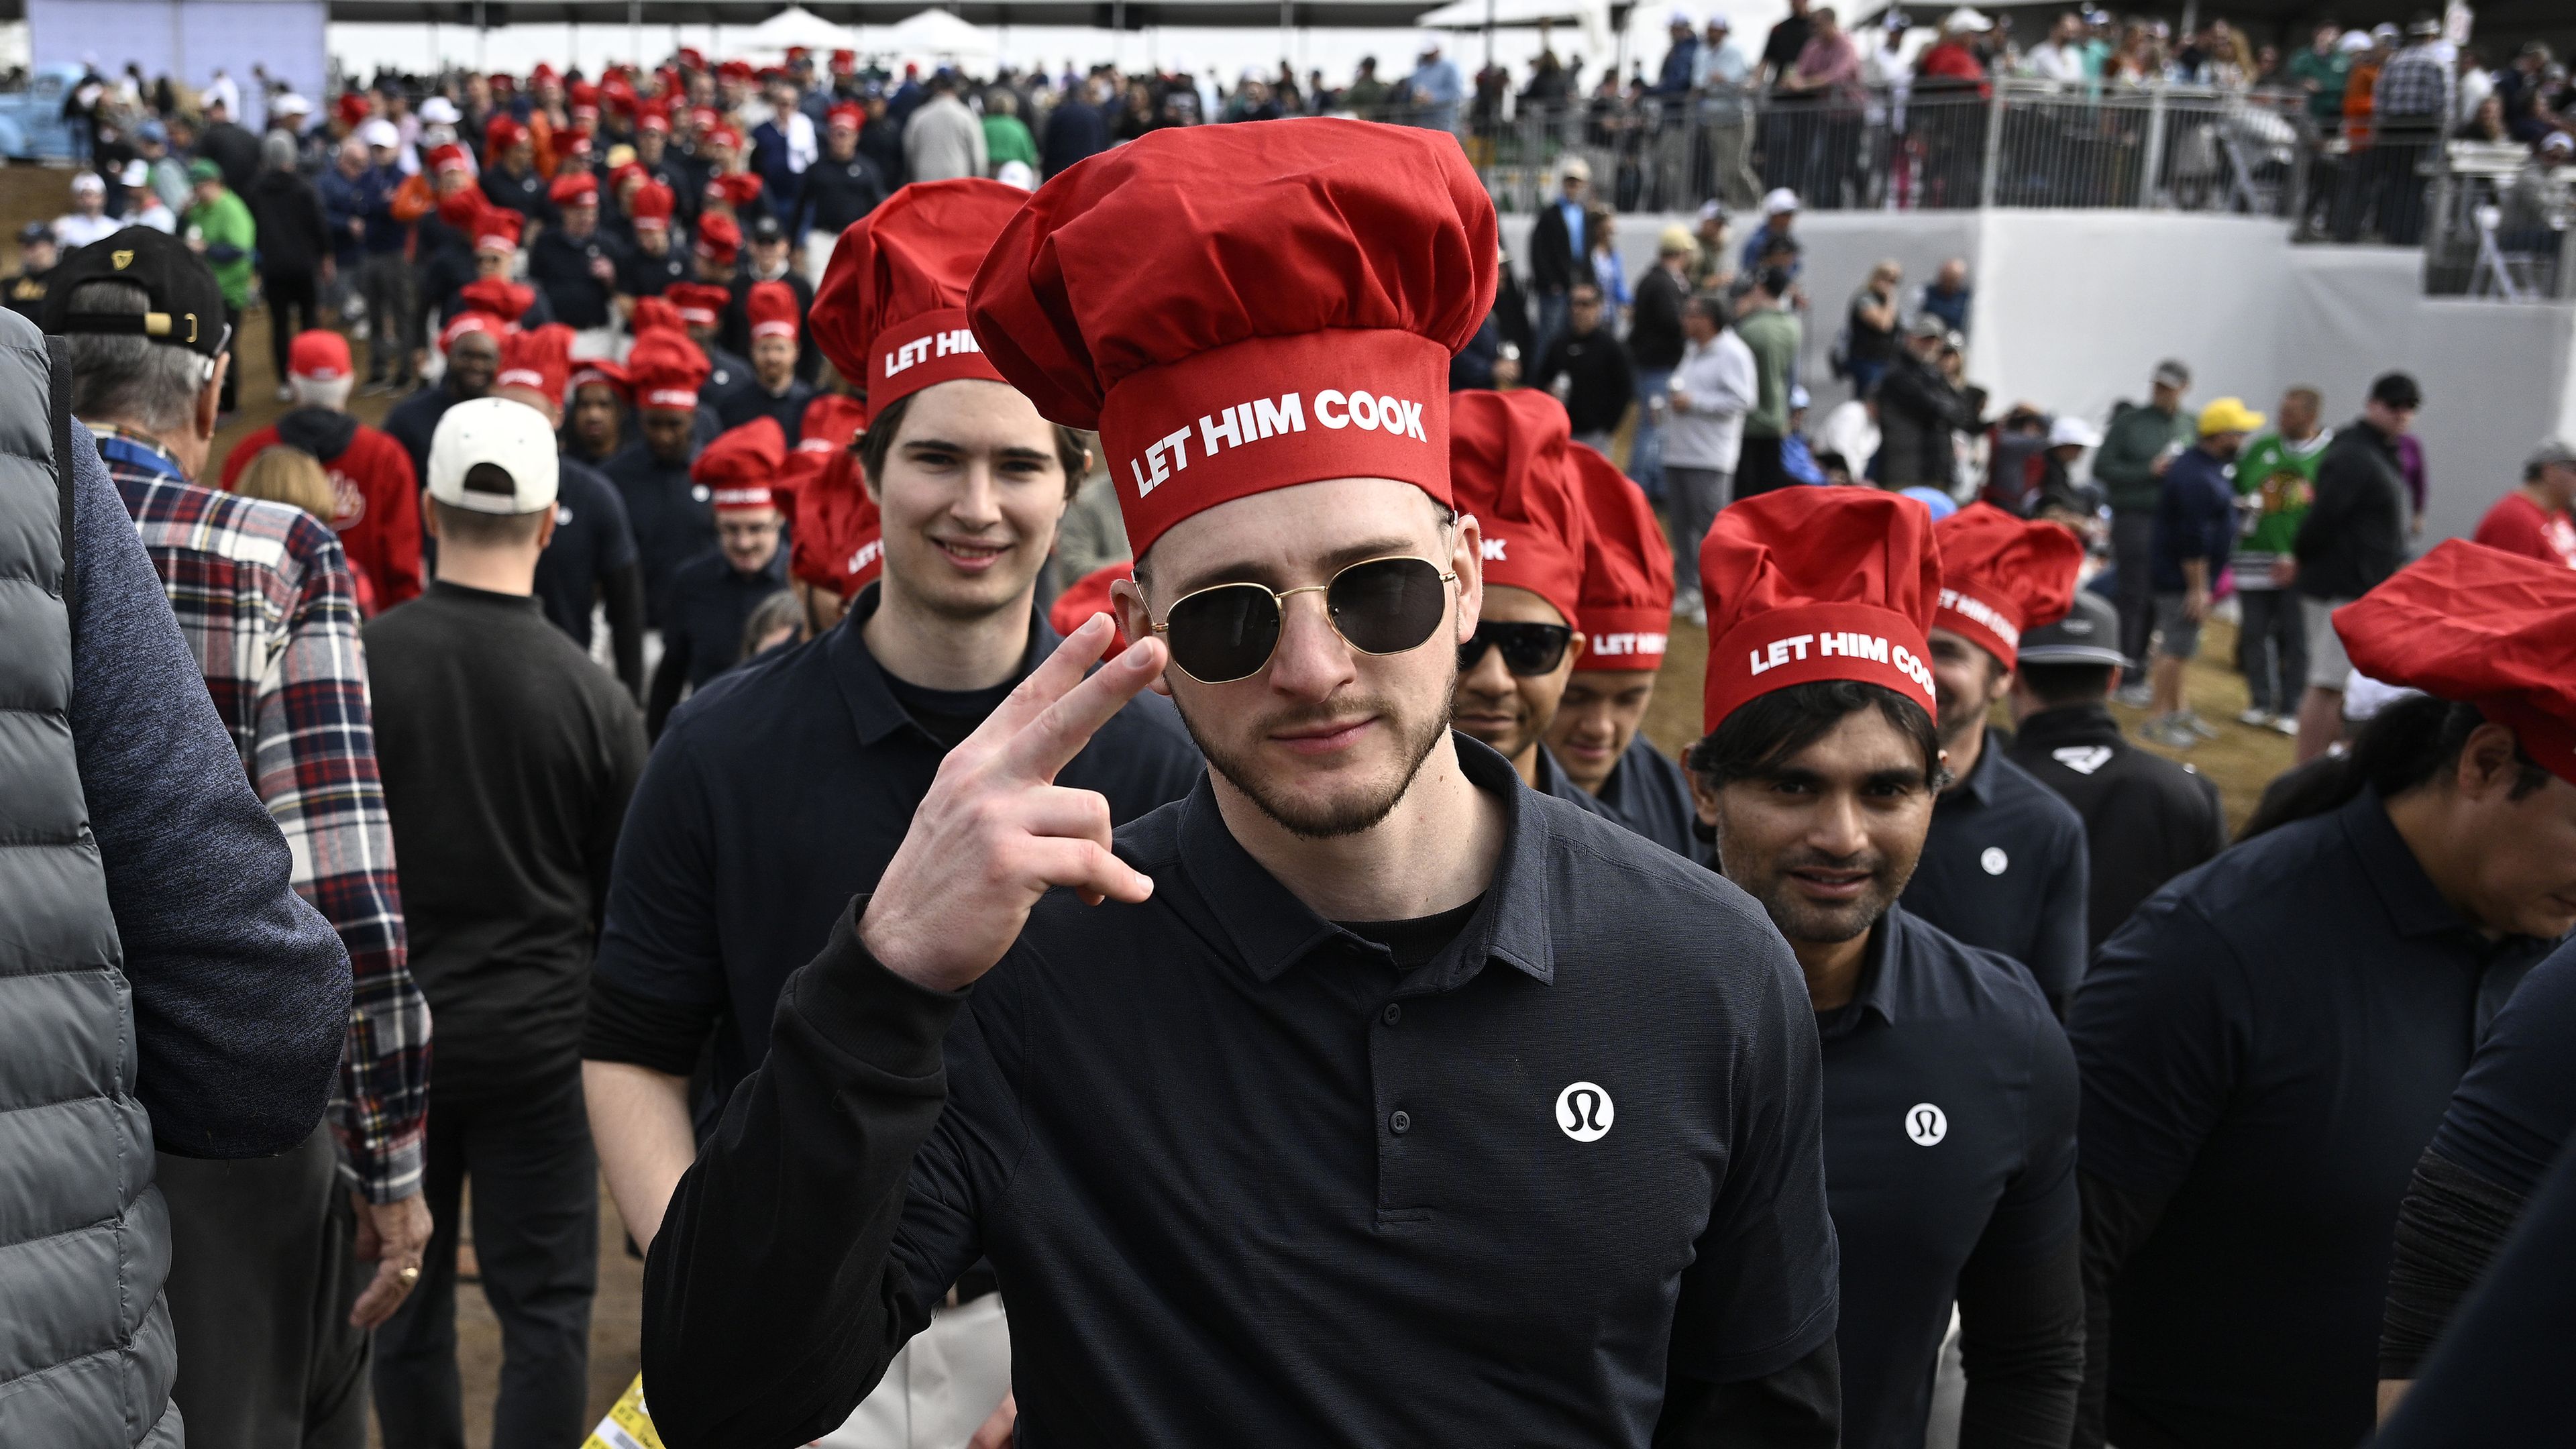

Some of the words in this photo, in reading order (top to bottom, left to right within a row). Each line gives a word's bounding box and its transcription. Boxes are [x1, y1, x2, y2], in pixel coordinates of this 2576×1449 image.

[885, 335, 933, 379] LET
[1130, 425, 1192, 499] LET
[1198, 392, 1307, 458] HIM
[1313, 389, 1428, 443] COOK
[1593, 633, 1636, 655] LET
[1750, 633, 1814, 676] LET
[1819, 632, 1888, 664] HIM
